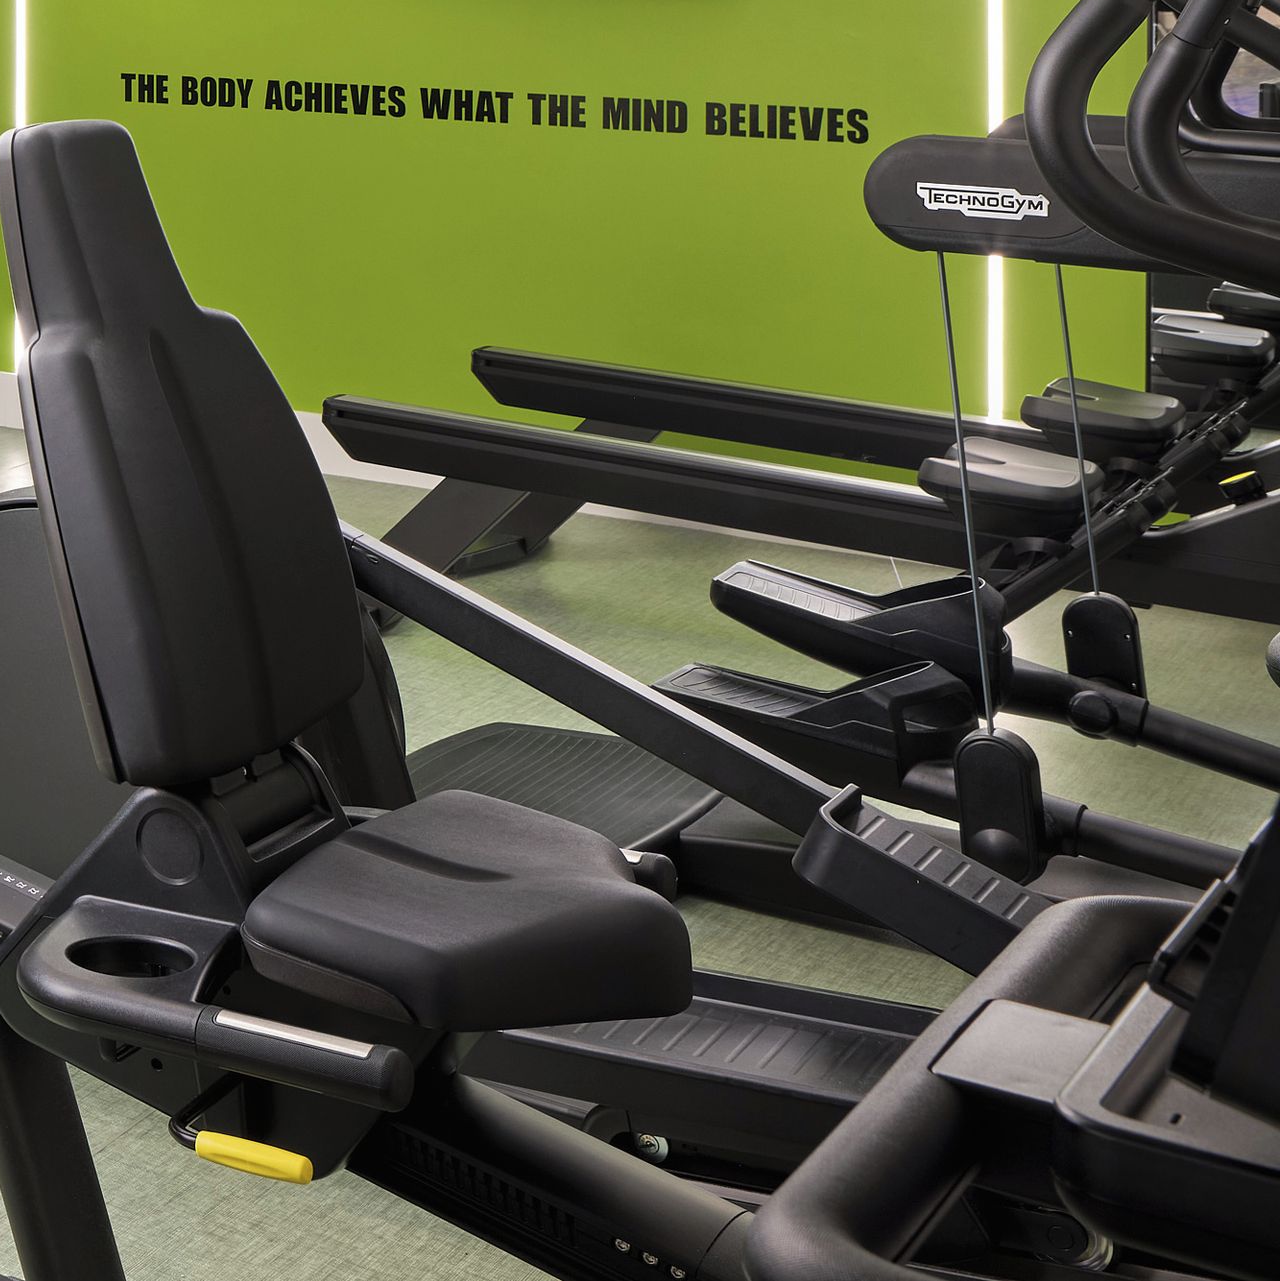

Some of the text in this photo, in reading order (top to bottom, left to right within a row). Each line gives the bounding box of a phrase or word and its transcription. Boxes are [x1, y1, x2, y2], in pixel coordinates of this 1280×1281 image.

[120, 73, 870, 145] THE BODY ACHIEVES WHAT THE MIND BELIEVES
